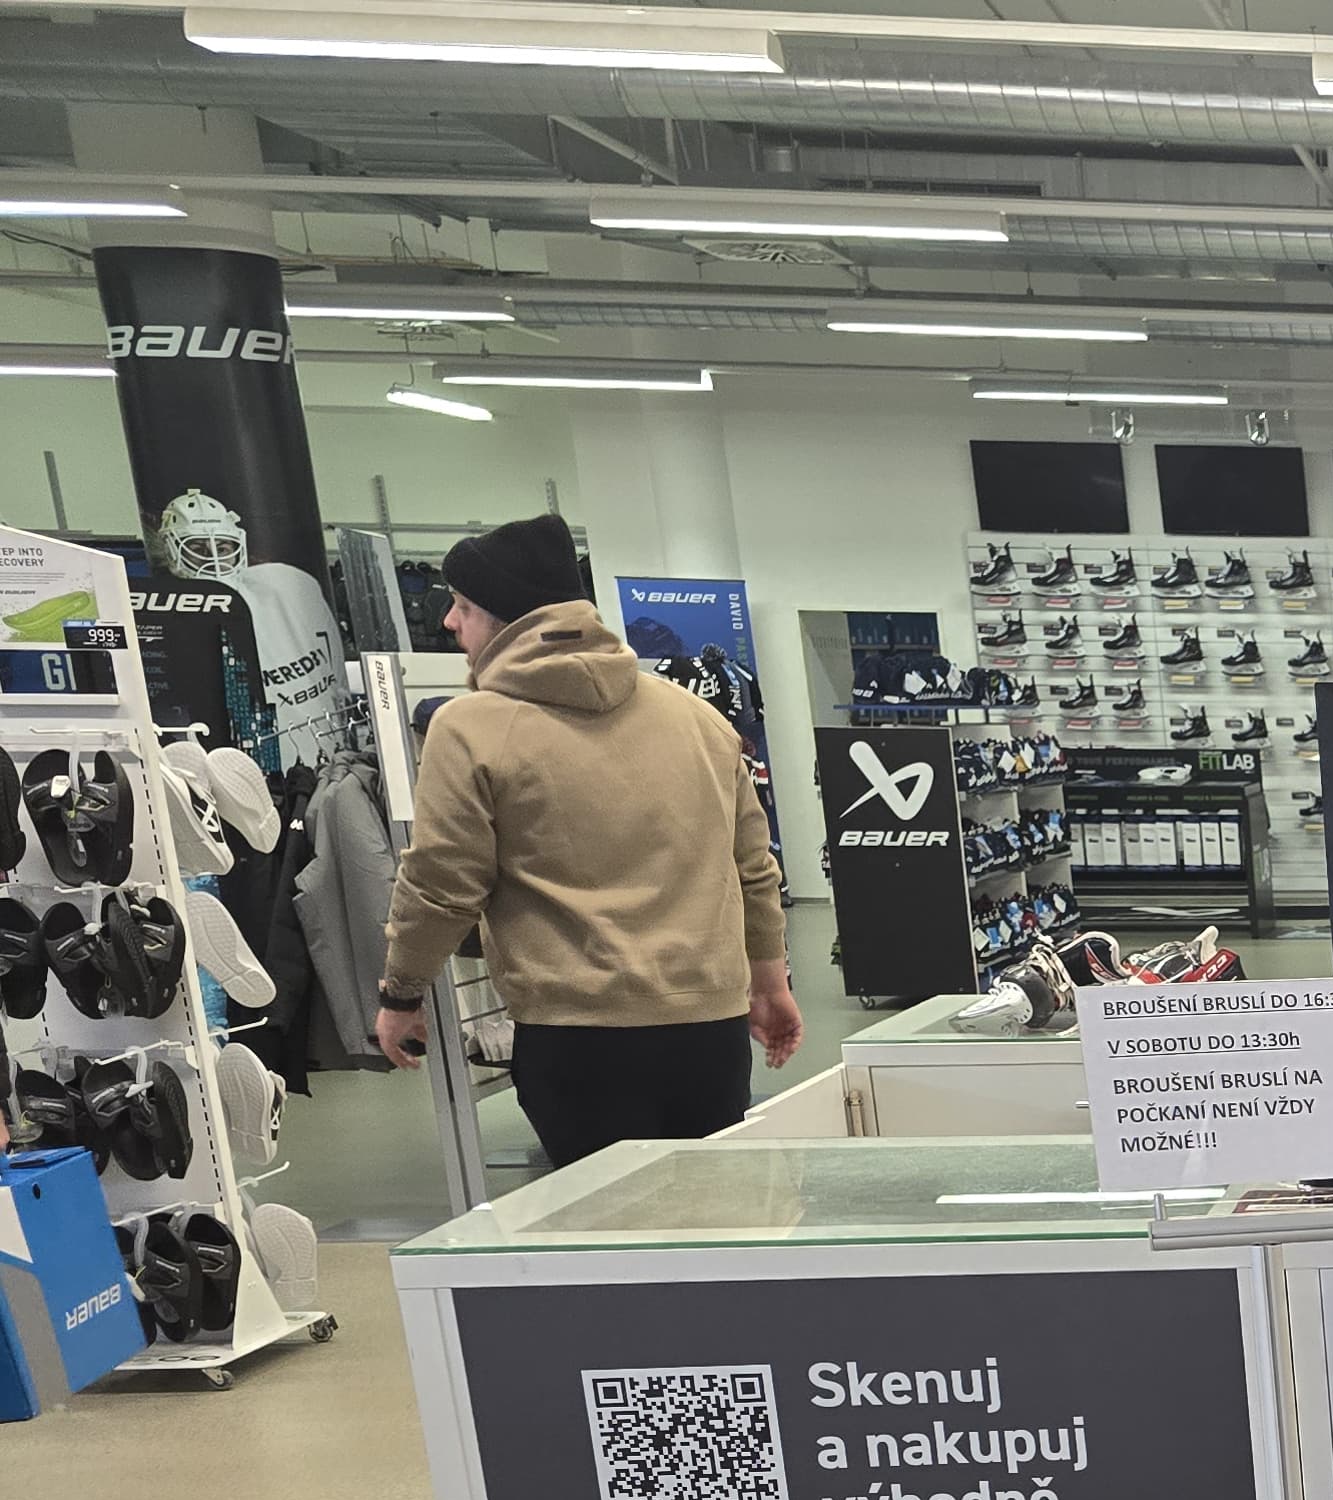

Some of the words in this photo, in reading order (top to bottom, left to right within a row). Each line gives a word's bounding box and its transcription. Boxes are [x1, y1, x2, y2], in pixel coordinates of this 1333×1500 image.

[0, 547, 14, 556] EP
[18, 547, 43, 556] INTO
[647, 591, 718, 605] BAUER
[728, 593, 744, 631] DAVID
[375, 660, 390, 711] BAUER
[838, 830, 950, 848] BAUER
[1103, 994, 1198, 1016] BROUŠENÍ
[1203, 990, 1266, 1011] BRUSLÍ
[1270, 993, 1298, 1008] DO
[1107, 1039, 1121, 1055] V
[1126, 1036, 1202, 1053] SOBOTU
[1207, 1035, 1235, 1050] DO
[1241, 1031, 1300, 1048] 13:30h
[1113, 1071, 1215, 1095] BROUŠENÍ
[1221, 1067, 1289, 1088] BRUSLÍ
[1294, 1069, 1323, 1085] NA
[1117, 1100, 1207, 1124] POČKANÍ
[1212, 1097, 1260, 1119] NENÍ
[1264, 1096, 1316, 1115] VŽDY
[1120, 1130, 1218, 1153] MOŽNÉ!!!
[65, 1283, 121, 1331] BAUER
[807, 1357, 1002, 1413] Skenuj
[816, 1434, 847, 1470] a
[866, 1417, 1089, 1474] nakupuj
